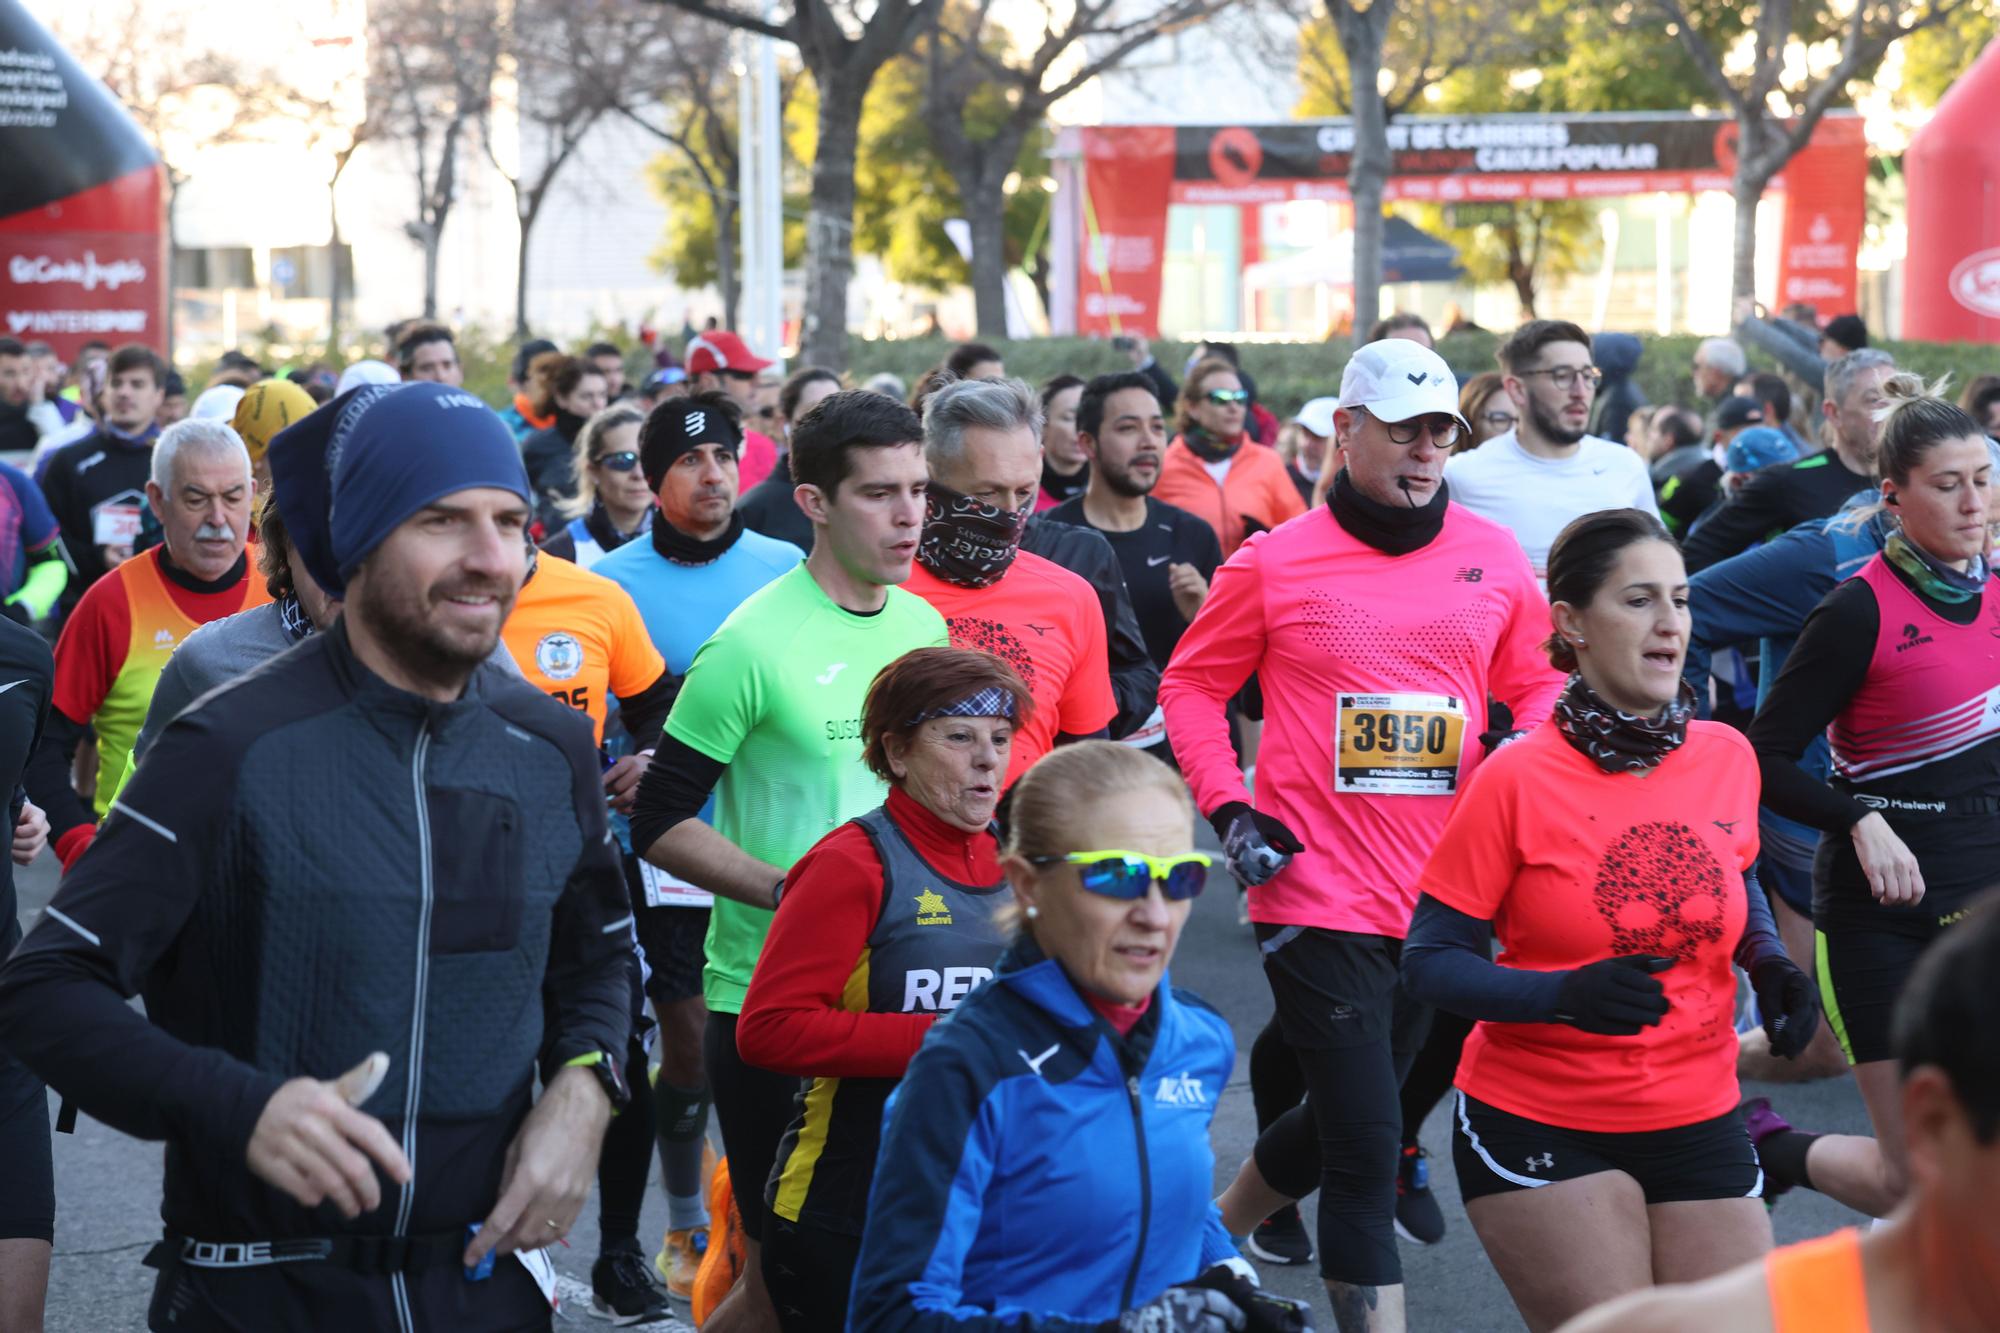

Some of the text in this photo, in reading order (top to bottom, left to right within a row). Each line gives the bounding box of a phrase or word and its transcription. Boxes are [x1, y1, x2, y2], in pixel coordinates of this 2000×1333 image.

[1411, 124, 1446, 150] DE
[1446, 121, 1570, 149] CARRERES
[1353, 713, 1447, 755] 3950
[1891, 799, 1946, 813] Kalenji
